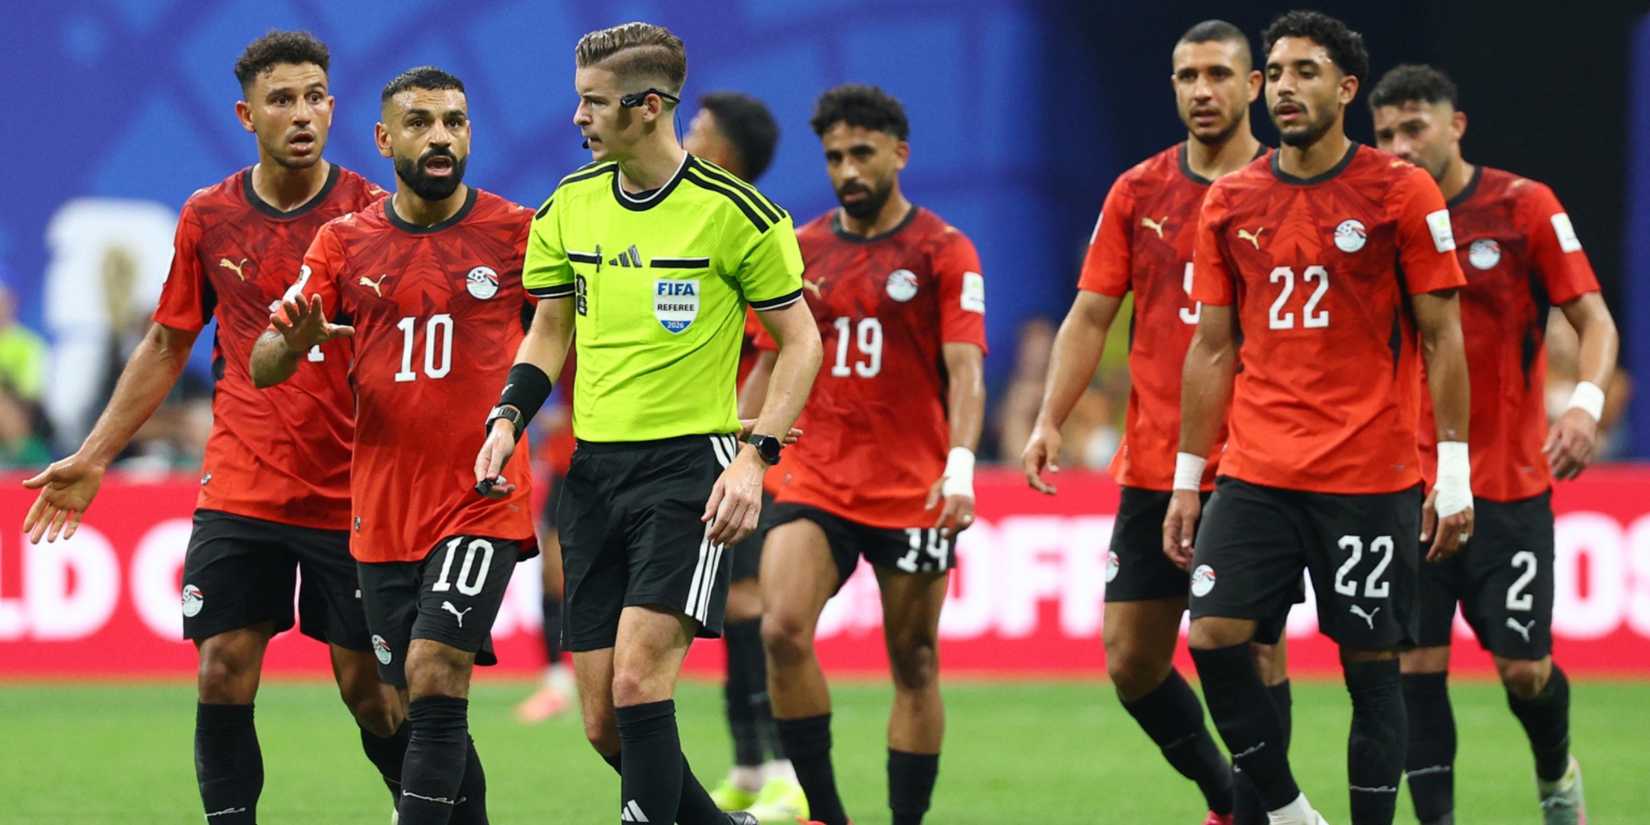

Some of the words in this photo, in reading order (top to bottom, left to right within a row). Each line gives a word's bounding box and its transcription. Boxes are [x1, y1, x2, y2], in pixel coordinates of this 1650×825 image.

[657, 282, 695, 296] FIFA
[657, 303, 695, 312] REFEREE
[1269, 265, 1329, 330] 22
[394, 313, 454, 382] 10
[832, 316, 883, 378] 19
[432, 536, 494, 596] 10
[1335, 535, 1394, 598] 22
[1506, 551, 1538, 611] 2
